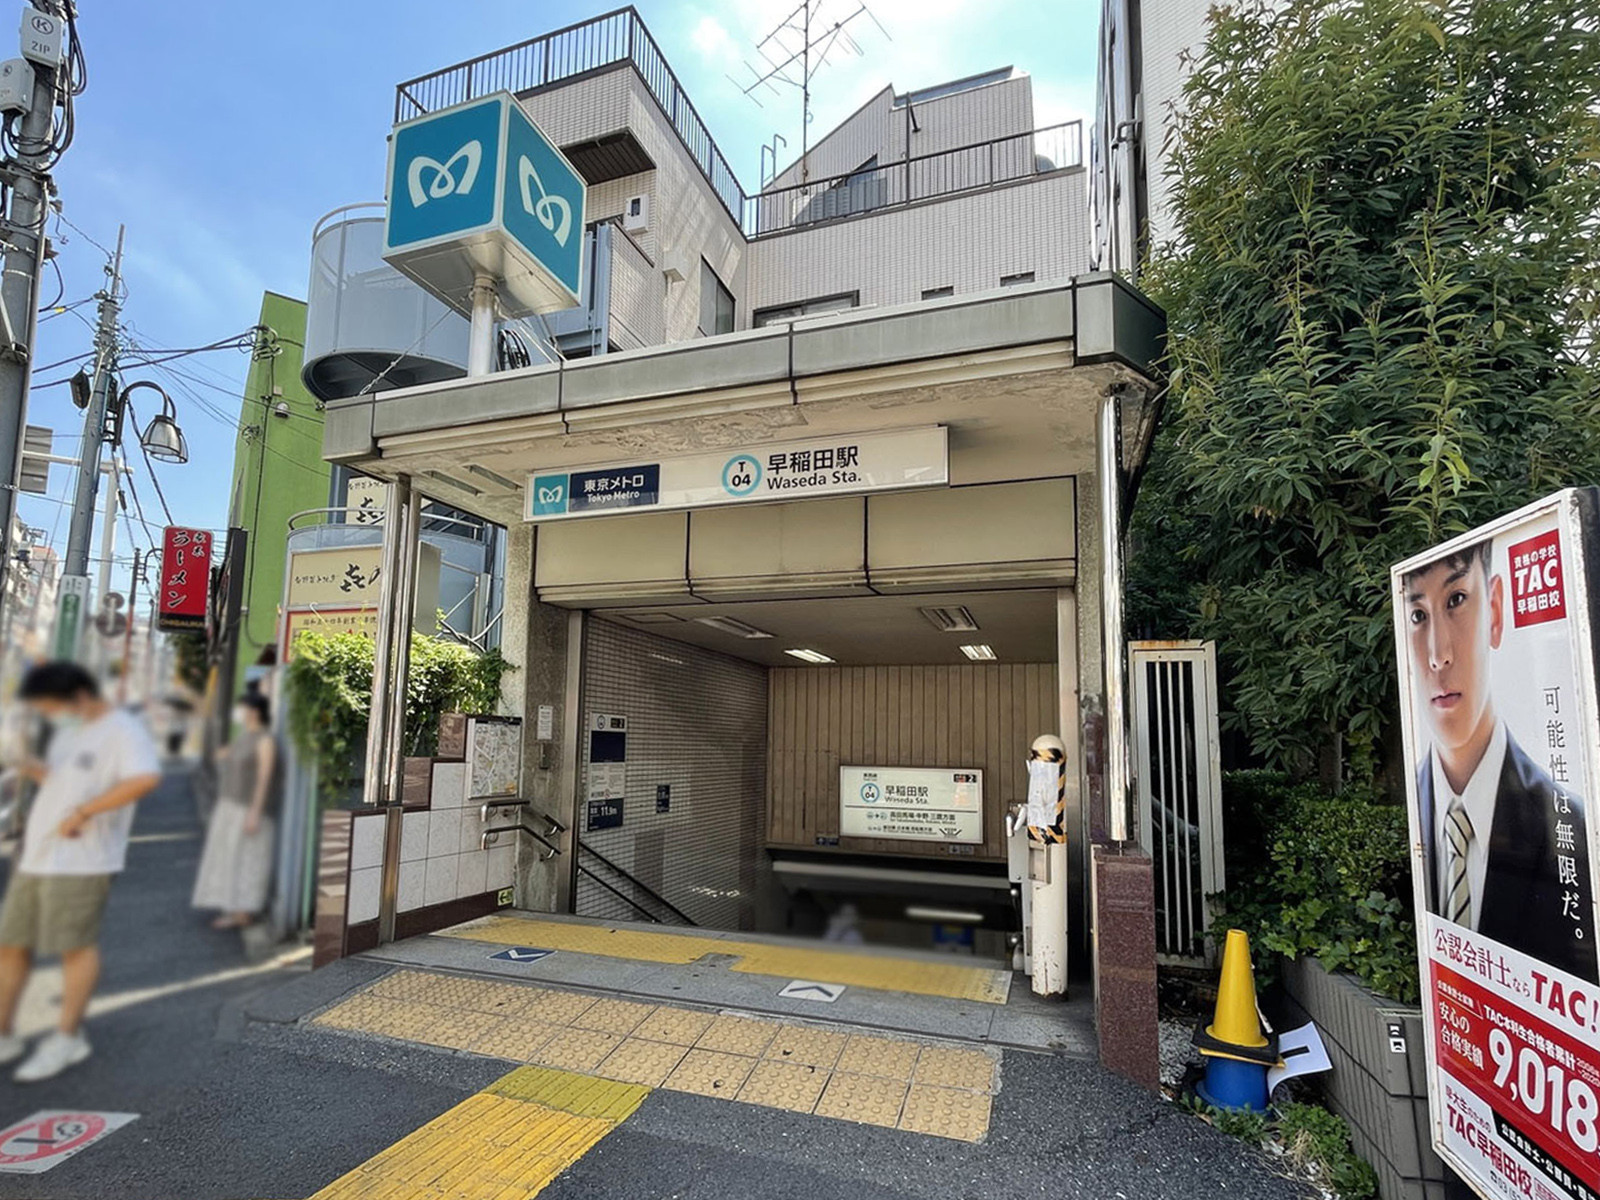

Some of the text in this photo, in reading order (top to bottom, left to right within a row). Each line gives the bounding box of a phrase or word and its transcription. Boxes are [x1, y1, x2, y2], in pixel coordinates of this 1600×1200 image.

[31, 40, 50, 54] ZIP
[738, 461, 746, 473] T
[767, 446, 858, 475] 早稲田駅
[583, 474, 644, 493] 東京メトロ
[732, 474, 751, 487] 04
[767, 470, 861, 490] Waseda Sta.
[587, 490, 640, 504] Tokyo Metro
[1514, 544, 1557, 569] 資格の学校
[167, 530, 190, 609] ラーメン
[1514, 558, 1559, 596] TAC
[1517, 590, 1561, 614] 早稲田校
[885, 785, 929, 798] 早稲田駅
[885, 797, 913, 805] Waseda
[1543, 685, 1584, 940] 可能性は無限だ。
[1439, 1001, 1470, 1034] 安心の
[1441, 1024, 1485, 1071] 合格実績
[1488, 1027, 1598, 1154] 9,018
[1446, 1102, 1533, 1200] TAC早稲田校
